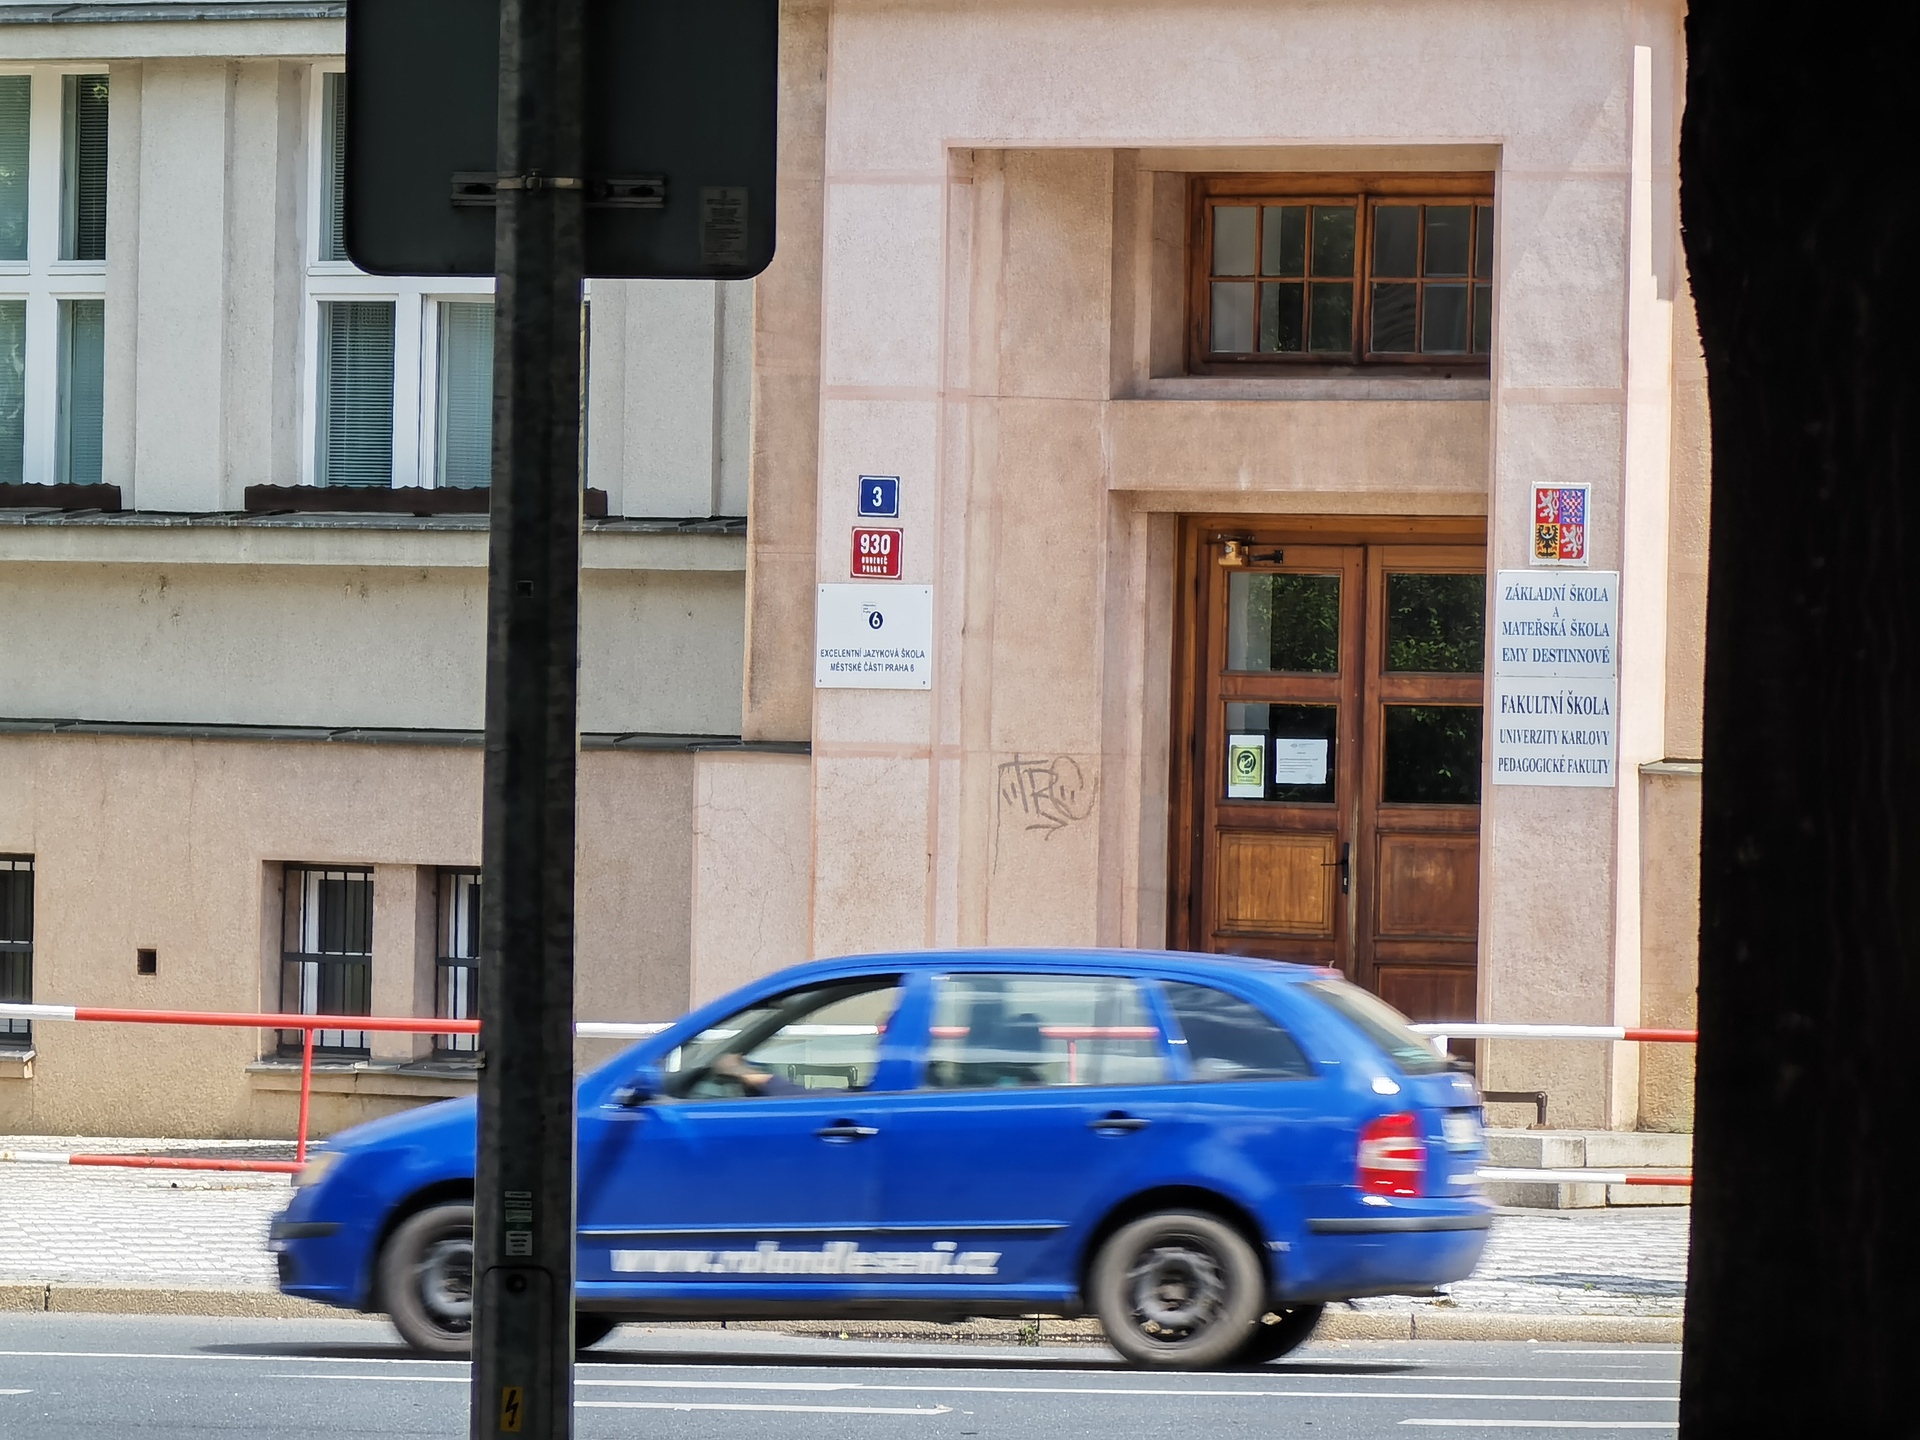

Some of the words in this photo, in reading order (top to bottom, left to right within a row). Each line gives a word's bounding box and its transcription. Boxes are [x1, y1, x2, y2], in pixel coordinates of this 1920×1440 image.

[872, 486, 883, 507] 3
[860, 533, 891, 555] 930
[1505, 583, 1566, 601] ZÁKLADNÍ
[1569, 583, 1609, 602] ŠKOLA
[1552, 606, 1560, 618] A
[1502, 618, 1567, 636] MATEŘSKÁ
[1570, 618, 1610, 637] ŠKOLA
[820, 647, 861, 658] EXCELENTNÍ
[863, 647, 899, 658] JAZYKOVÁ
[900, 648, 925, 659] ŠKOLA
[1502, 647, 1529, 662] EMY
[1532, 645, 1610, 663] DESTINNOVÉ
[830, 661, 861, 672] MĚSTSKÉ
[863, 661, 884, 672] ČÁSTI
[885, 663, 909, 672] PRAHA
[909, 663, 915, 672] 6
[1501, 690, 1564, 714] FAKULTNÍ
[1566, 690, 1610, 715] ŠKOLA
[1500, 729, 1560, 745] UNIVERZITY
[1561, 730, 1610, 746] KARLOVY
[1498, 754, 1566, 773] PEDAGOGICKÉ
[1567, 758, 1610, 774] FAKULTY
